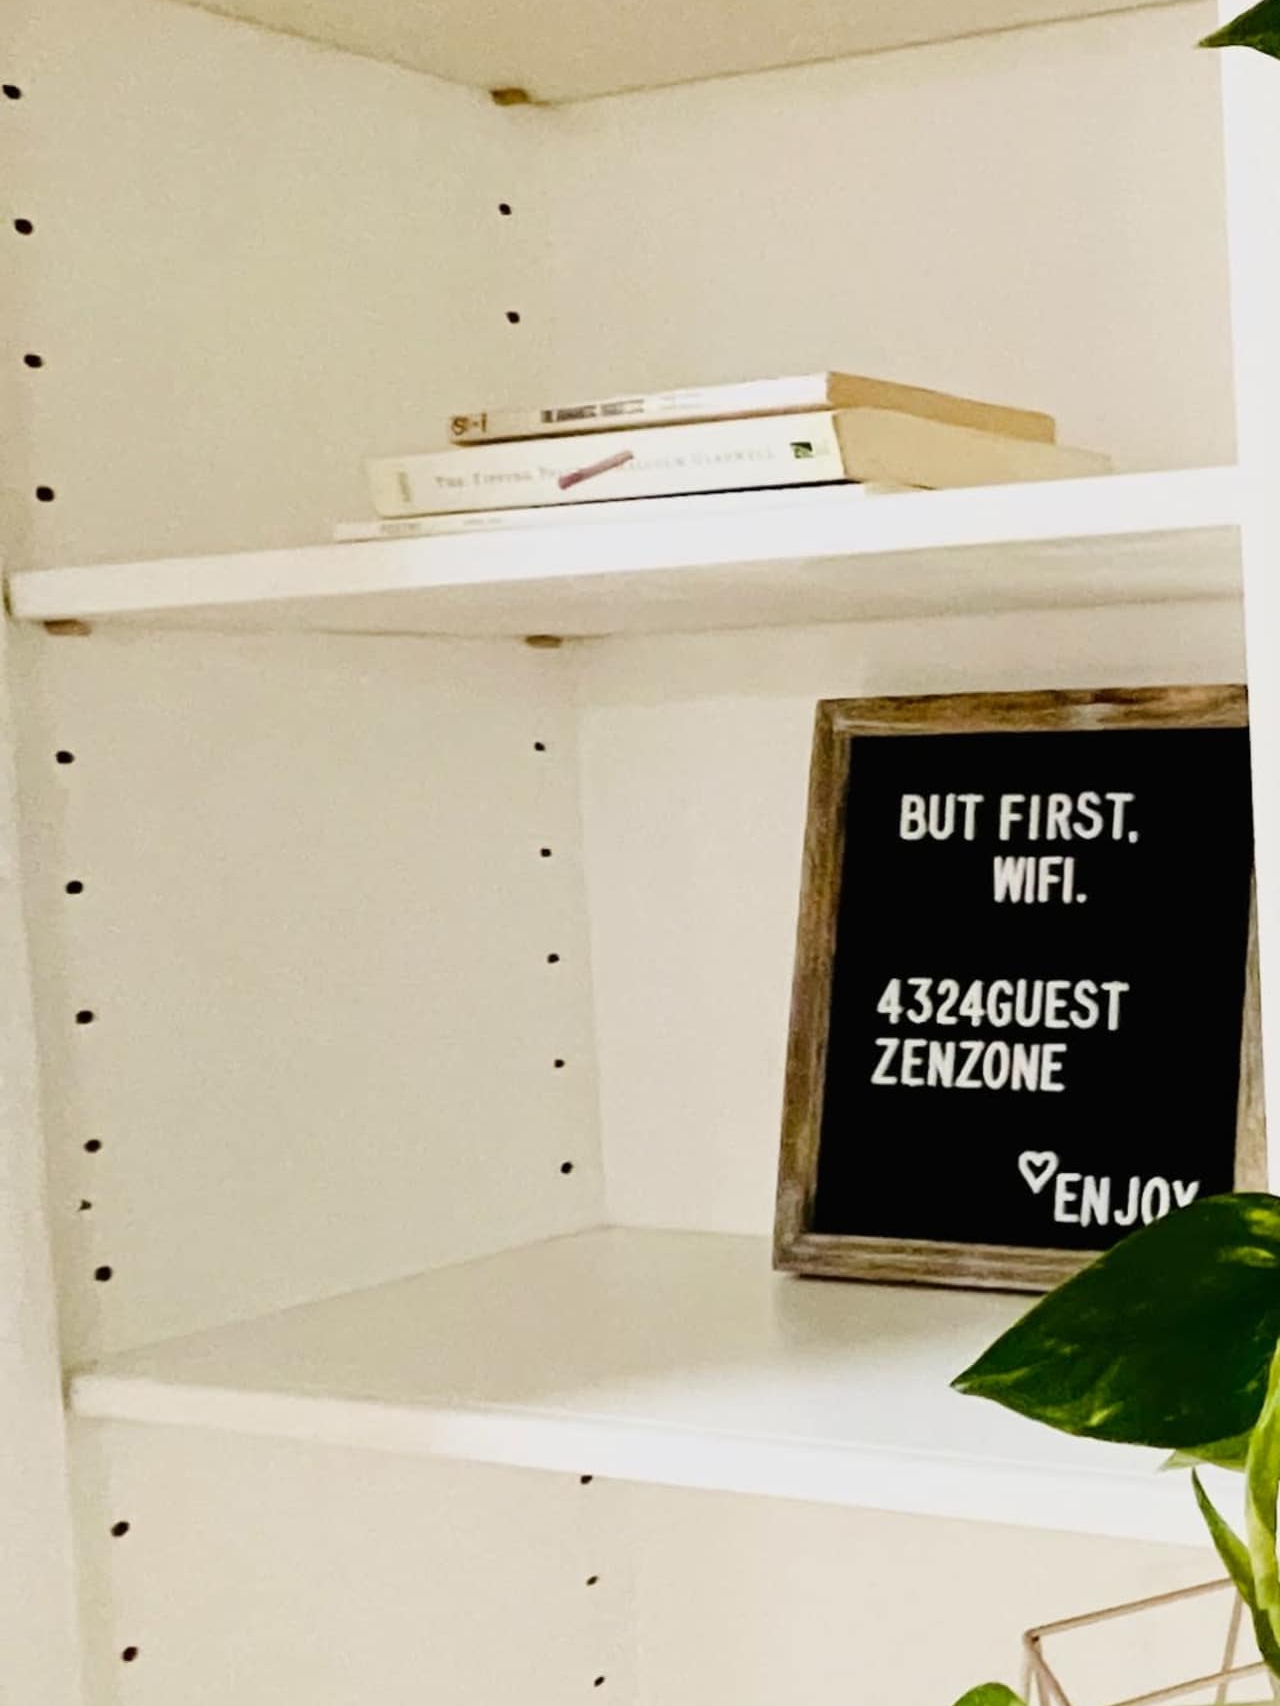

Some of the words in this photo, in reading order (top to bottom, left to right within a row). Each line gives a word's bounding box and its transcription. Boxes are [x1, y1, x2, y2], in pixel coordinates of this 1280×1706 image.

[899, 793, 984, 843] BUT
[998, 791, 1139, 845] FIRST,
[993, 855, 1088, 904] WIFI.
[876, 977, 1130, 1031] 4324GUEST
[871, 1038, 1068, 1092] ZENZONE
